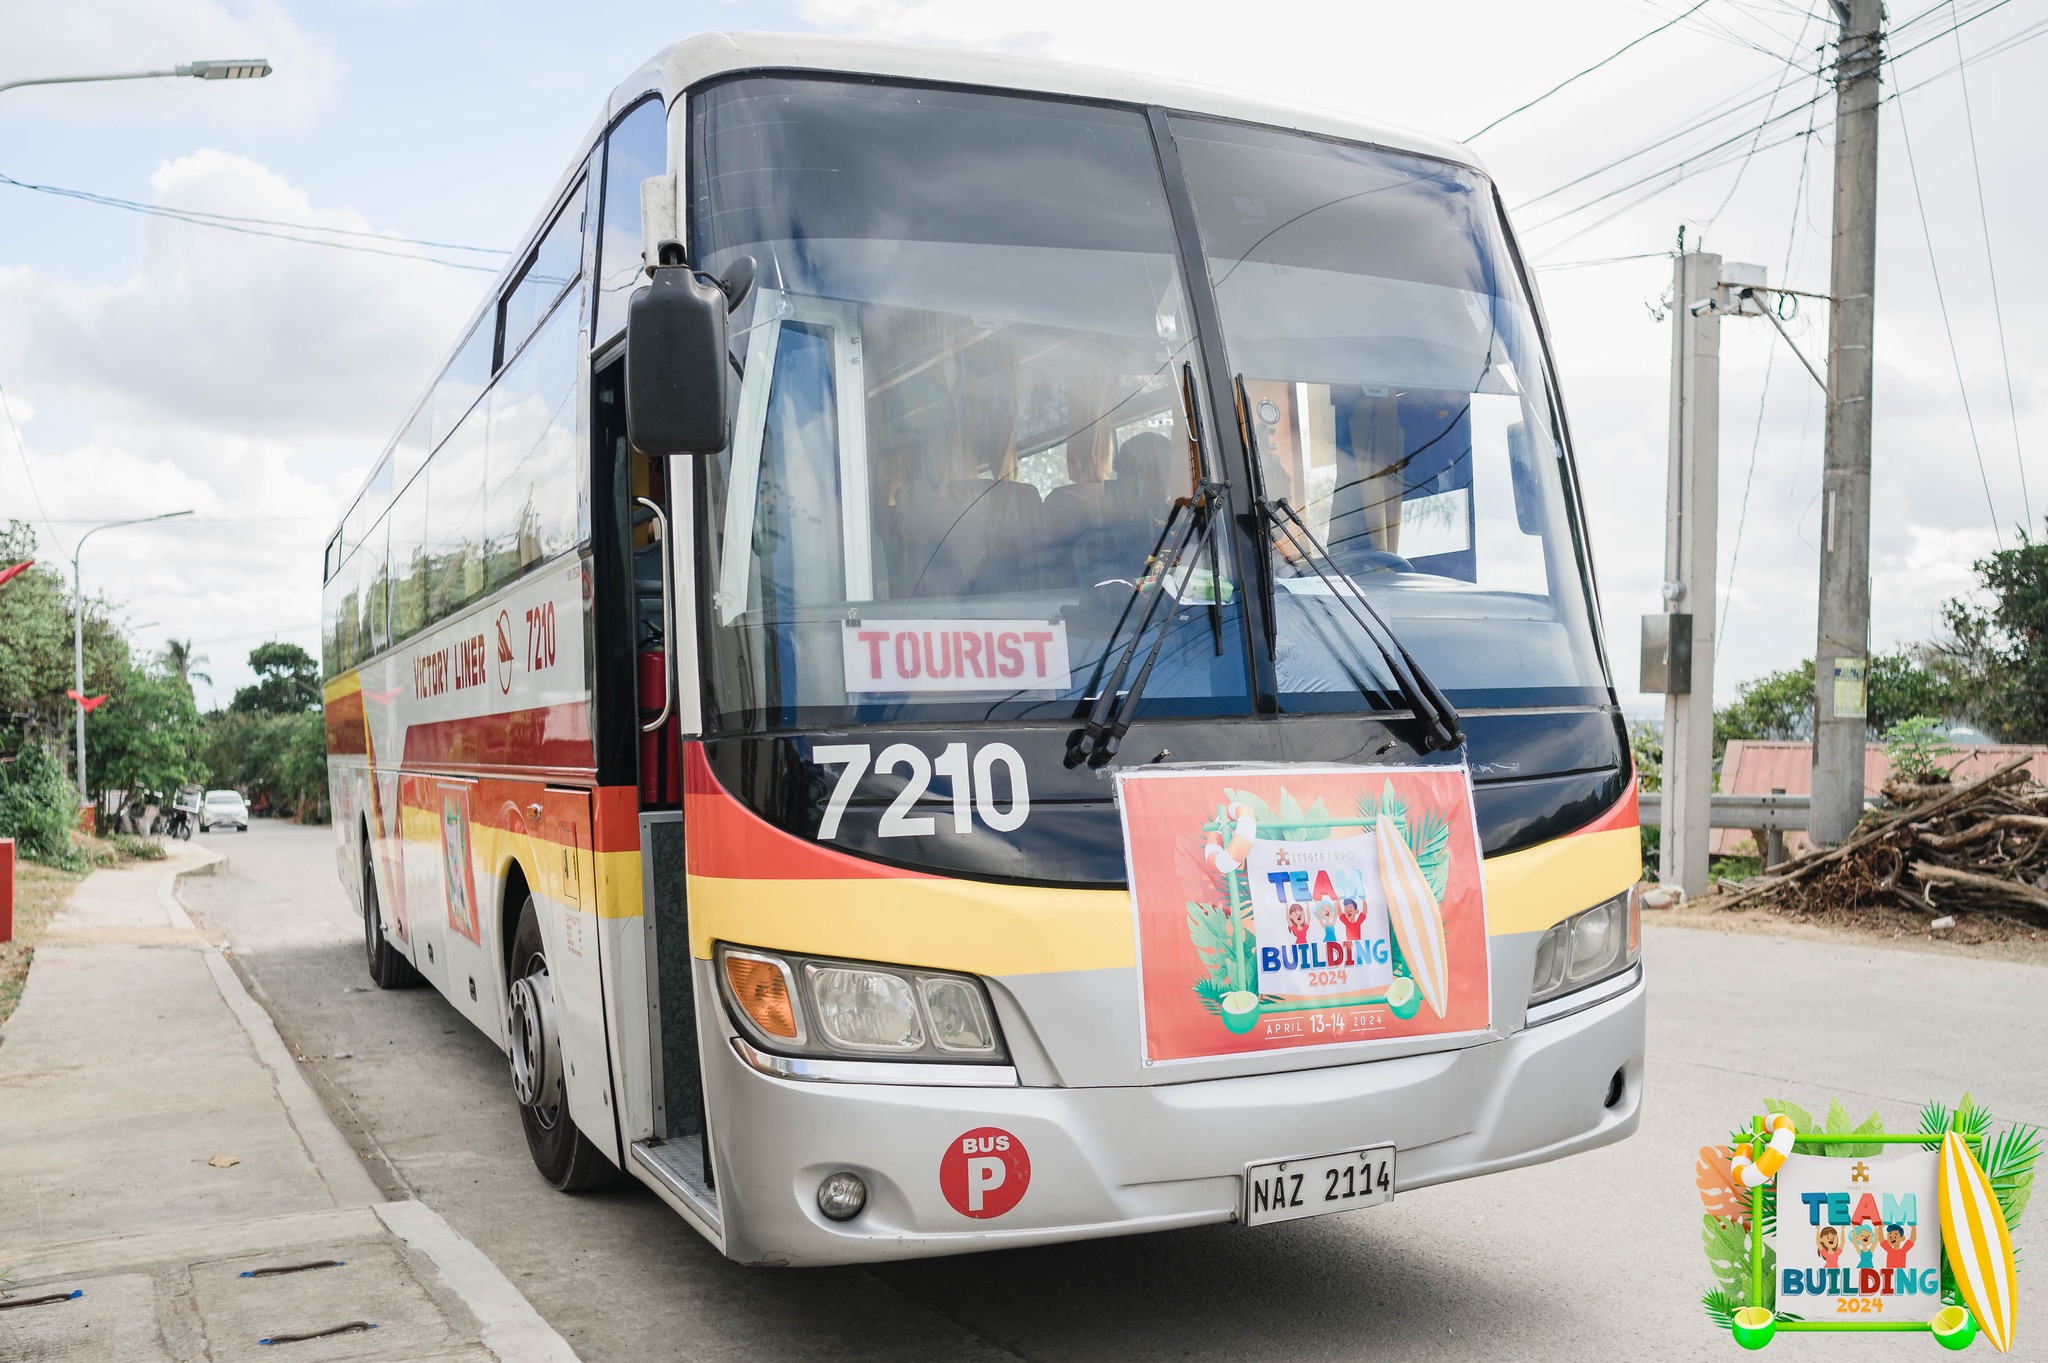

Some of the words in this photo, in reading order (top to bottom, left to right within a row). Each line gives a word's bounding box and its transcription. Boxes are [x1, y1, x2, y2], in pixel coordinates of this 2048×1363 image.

[526, 600, 556, 673] 7210
[858, 631, 1053, 679] TOURIST
[413, 647, 449, 700] VICTORY
[454, 634, 486, 690] LINER
[812, 742, 1030, 840] 7210
[1267, 869, 1367, 904] TEAM
[1261, 939, 1389, 975] BUILDING
[1308, 969, 1348, 988] 2024
[1266, 1022, 1303, 1035] APRIL
[1309, 1012, 1346, 1034] 13-14
[1353, 1015, 1383, 1027] 2024
[962, 1135, 1010, 1154] BUS
[967, 1156, 1006, 1212] P
[1254, 1173, 1304, 1213] NAZ
[1324, 1160, 1390, 1201] 2114
